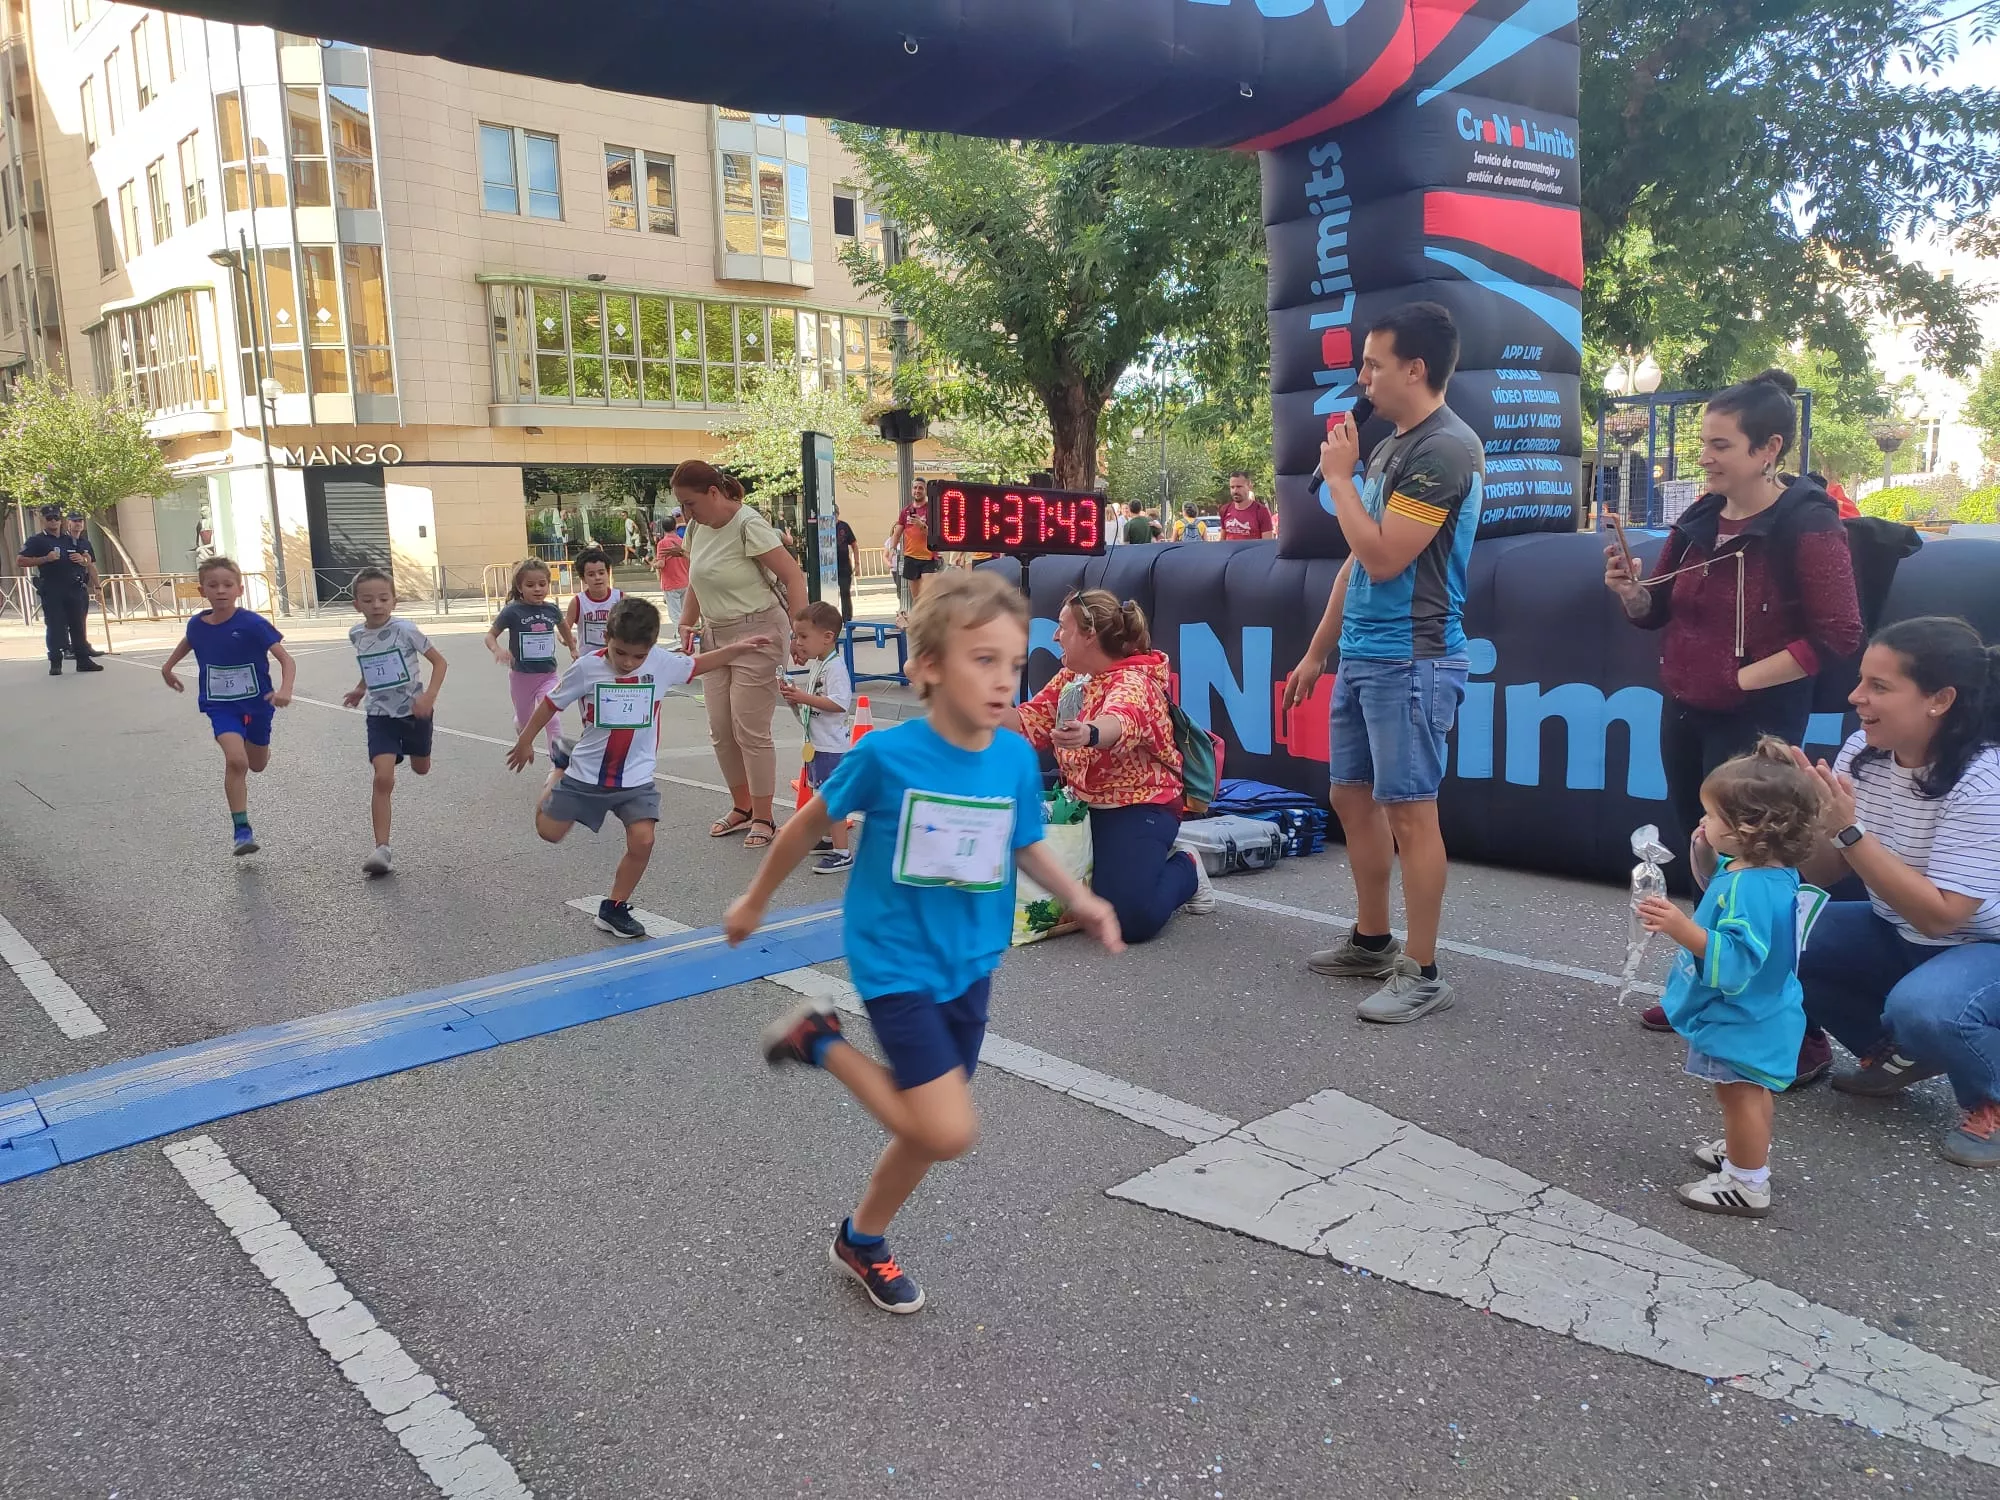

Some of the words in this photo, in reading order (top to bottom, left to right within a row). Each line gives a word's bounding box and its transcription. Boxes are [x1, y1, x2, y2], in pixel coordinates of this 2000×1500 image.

[1473, 150, 1501, 166] Servicio
[1502, 155, 1511, 168] de
[1512, 159, 1555, 177] cronometraje
[1554, 168, 1560, 179] y
[1466, 169, 1493, 184] gestión
[1494, 171, 1504, 185] de
[1504, 177, 1531, 189] eventos
[1531, 180, 1563, 195] deportivos
[1501, 345, 1523, 360] APP
[1523, 346, 1544, 361] LIVE
[1491, 387, 1522, 404] VÍDEO
[1523, 389, 1560, 404] RESUMEN
[1494, 414, 1528, 429] VALLAS
[1530, 414, 1537, 428] Y
[1537, 414, 1561, 429] ARCOS
[282, 443, 403, 466] MANGO
[1485, 439, 1512, 453] BOLSA
[1514, 439, 1560, 452] CORREDOR
[1485, 459, 1525, 473] SPEAKER
[1526, 458, 1533, 471] Y
[1484, 481, 1524, 499] TROFEOS
[1527, 481, 1534, 495] Y
[1535, 481, 1572, 495] MEDALLAS
[1482, 508, 1504, 524] CHIP
[1504, 505, 1539, 520] ACTIVO
[1544, 505, 1571, 518] PASIVO
[622, 702, 633, 713] 24
